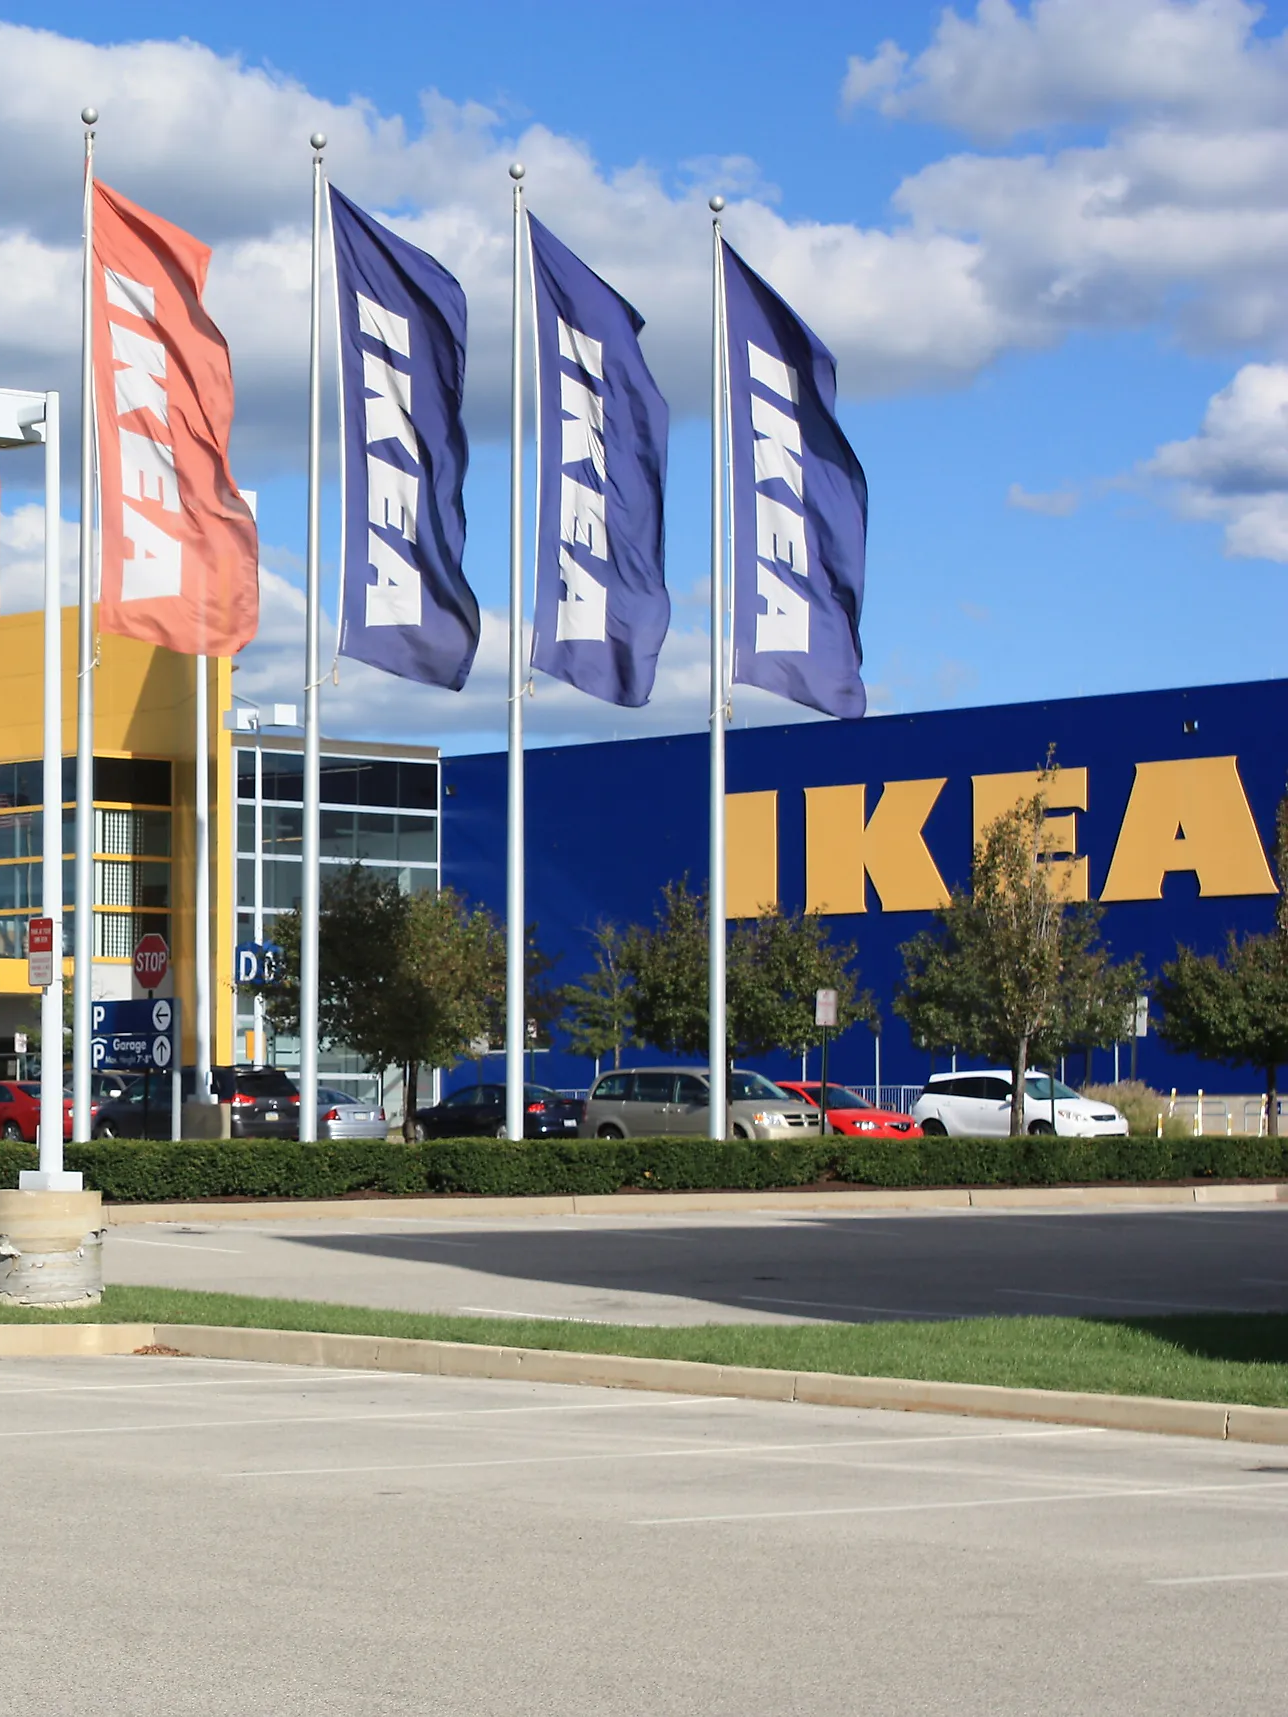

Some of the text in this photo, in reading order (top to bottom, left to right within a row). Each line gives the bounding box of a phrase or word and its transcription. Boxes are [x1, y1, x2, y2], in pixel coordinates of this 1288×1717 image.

[104, 267, 182, 602] IKEA
[356, 291, 422, 627] IKEA
[555, 315, 608, 642] IKEA
[747, 340, 810, 653] IKEA
[725, 755, 1279, 919] IKEA
[93, 1006, 105, 1030] P
[136, 952, 166, 972] STOP
[239, 951, 258, 981] D
[112, 1038, 147, 1054] Garage
